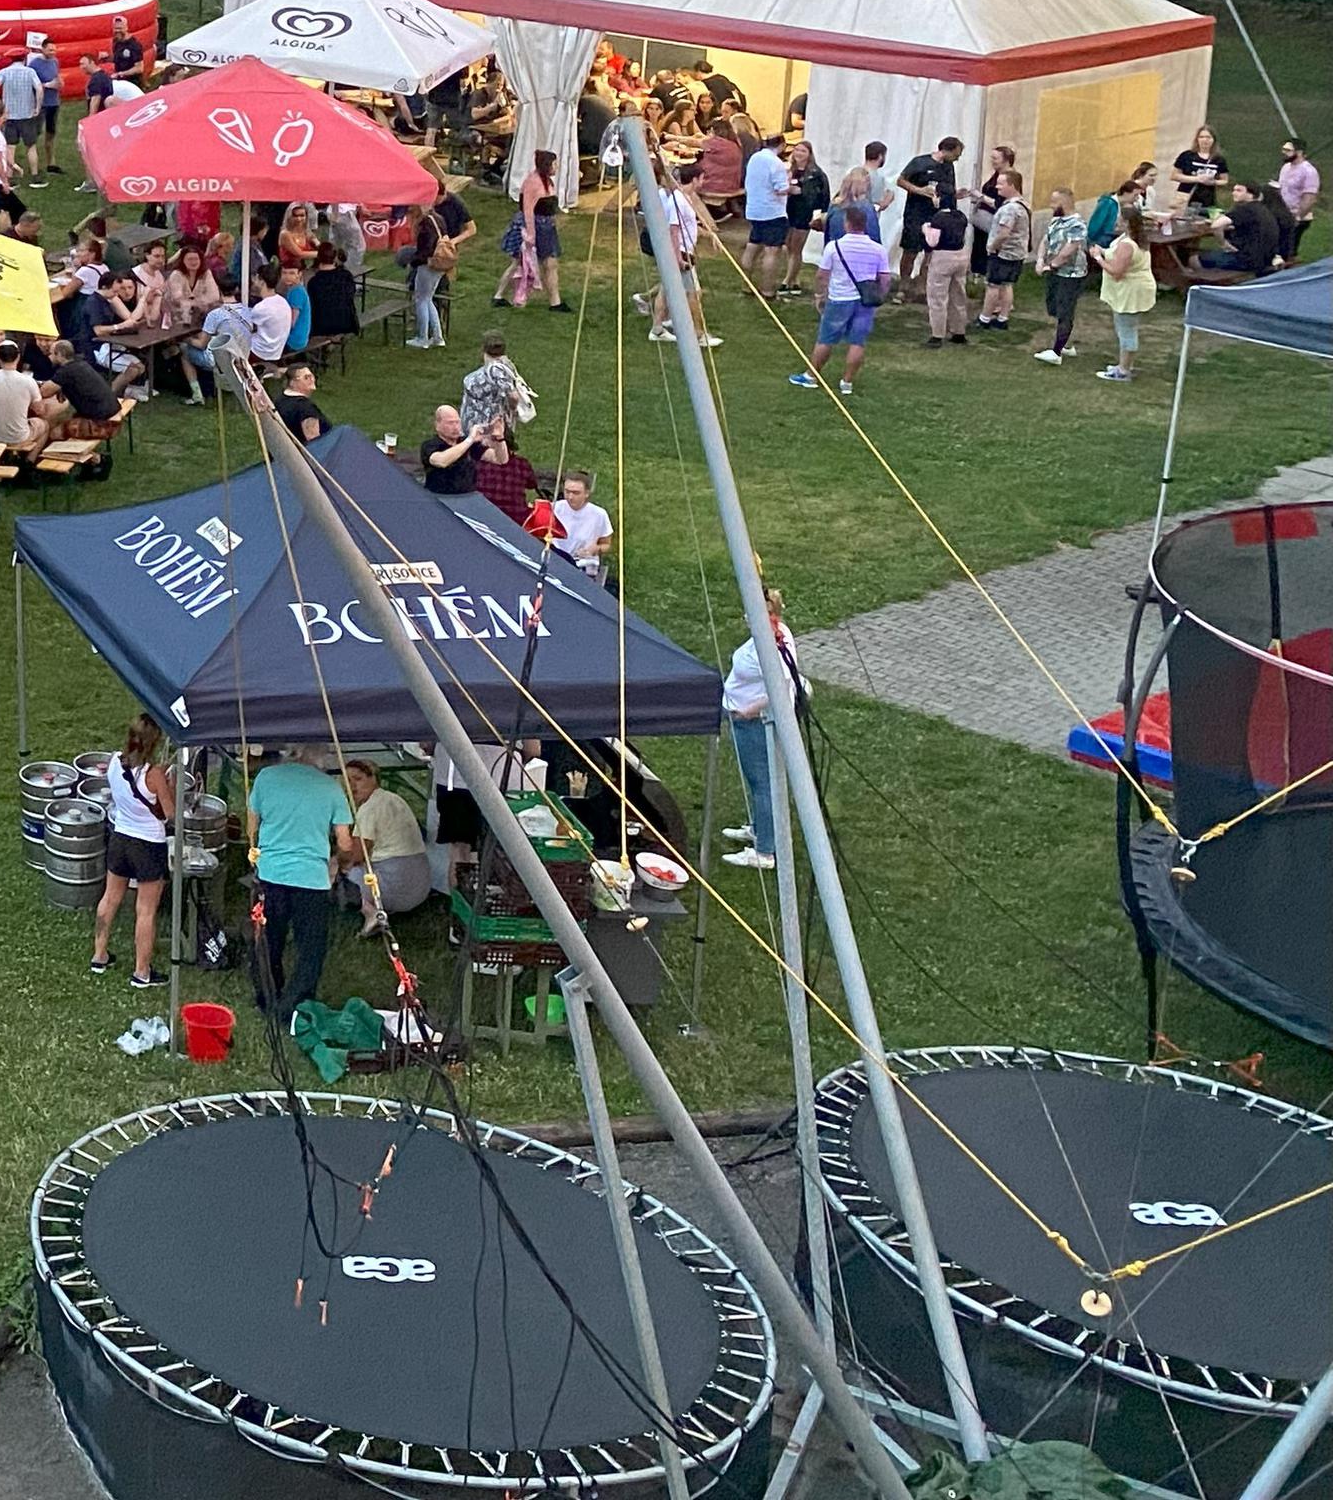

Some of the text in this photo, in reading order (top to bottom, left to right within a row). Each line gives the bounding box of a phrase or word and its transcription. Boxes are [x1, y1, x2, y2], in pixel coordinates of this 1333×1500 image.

[269, 38, 327, 52] ALGIDA
[211, 54, 241, 65] ALGI
[163, 177, 235, 193] ALGIDA
[113, 515, 240, 619] BOHÉM
